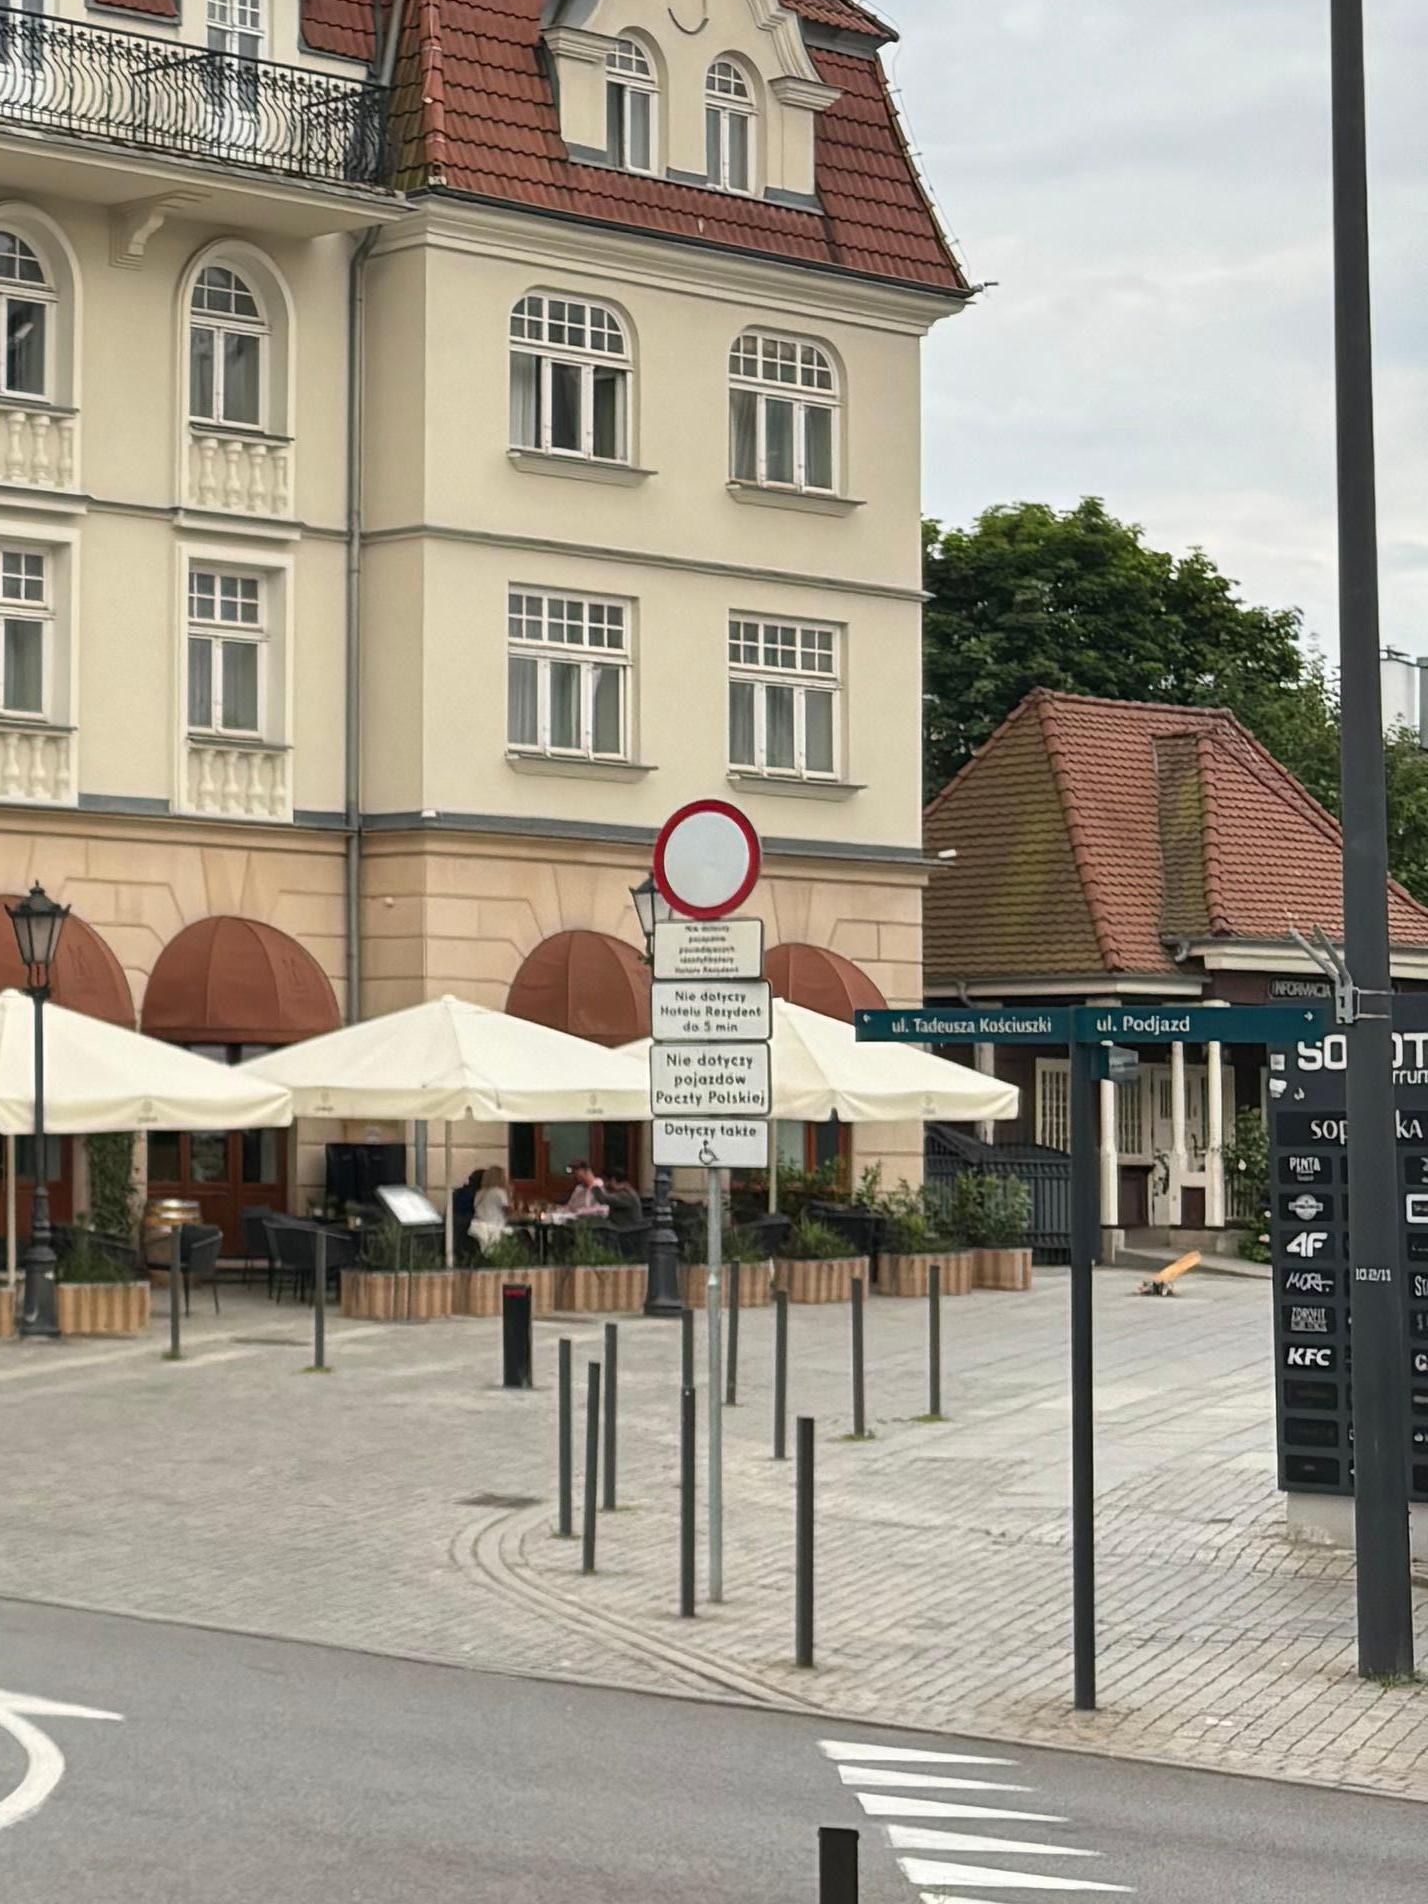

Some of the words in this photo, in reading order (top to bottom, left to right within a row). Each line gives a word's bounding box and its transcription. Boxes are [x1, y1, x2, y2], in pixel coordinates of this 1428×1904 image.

[675, 991, 696, 1002] Nie
[700, 991, 746, 1003] dotyczy
[660, 1005, 701, 1017] Hotelu
[705, 1005, 762, 1019] Rezydent
[682, 1021, 699, 1032] do
[704, 1022, 711, 1032] 5
[715, 1021, 738, 1032] min
[892, 1016, 909, 1033] ul.
[914, 1018, 975, 1033] Tadeusza
[979, 1015, 1052, 1033] Kościuszki
[1096, 1015, 1118, 1032] ul.
[1122, 1015, 1190, 1035] Podjazd
[666, 1053, 691, 1067] Nie
[697, 1053, 753, 1069] dotyczy
[656, 1090, 703, 1106] Poczty
[708, 1090, 765, 1106] Polskiej
[664, 1123, 716, 1139] Dotyczy
[1289, 1156, 1321, 1174] PINTA
[1286, 1231, 1328, 1258] 4F
[1287, 1346, 1332, 1366] KFC
